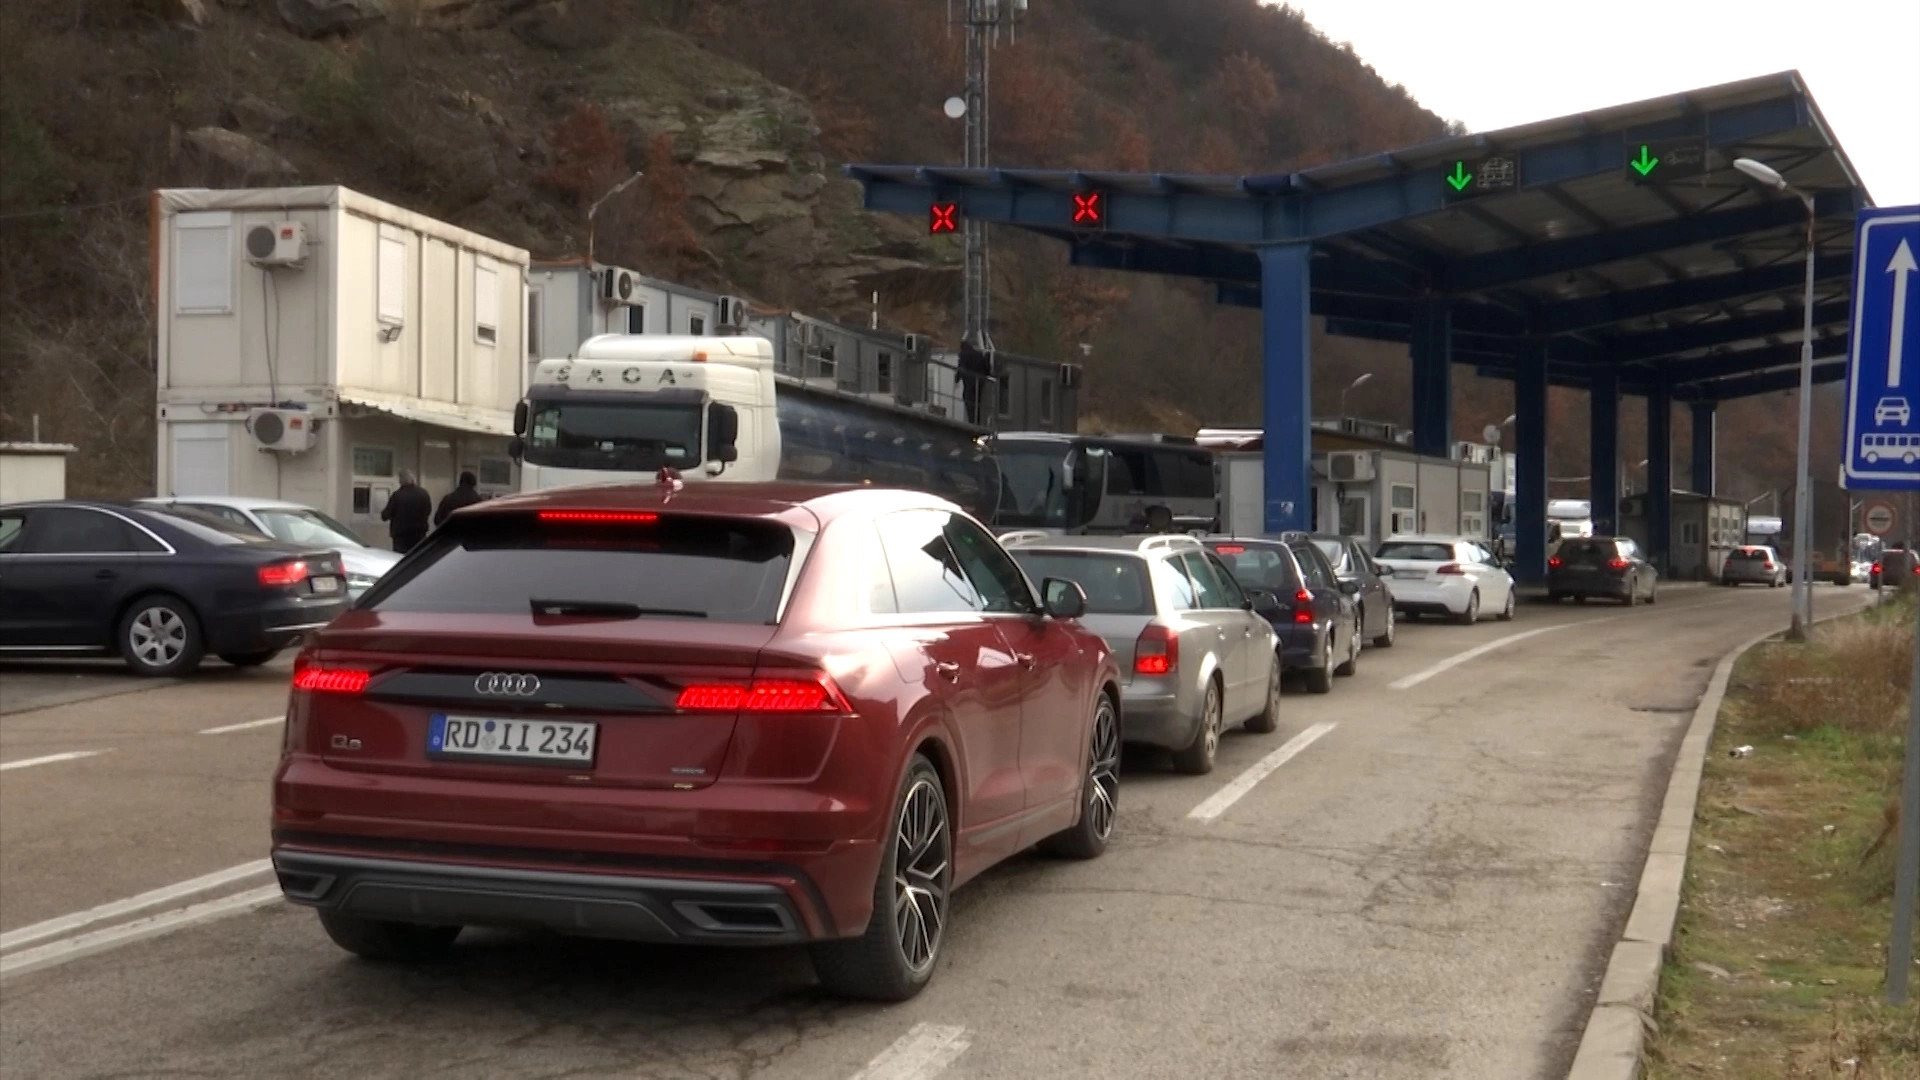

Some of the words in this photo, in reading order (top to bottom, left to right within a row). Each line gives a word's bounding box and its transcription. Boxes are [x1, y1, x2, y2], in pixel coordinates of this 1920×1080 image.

[445, 720, 480, 748] RD
[498, 723, 530, 752] II
[538, 725, 589, 756] 234
